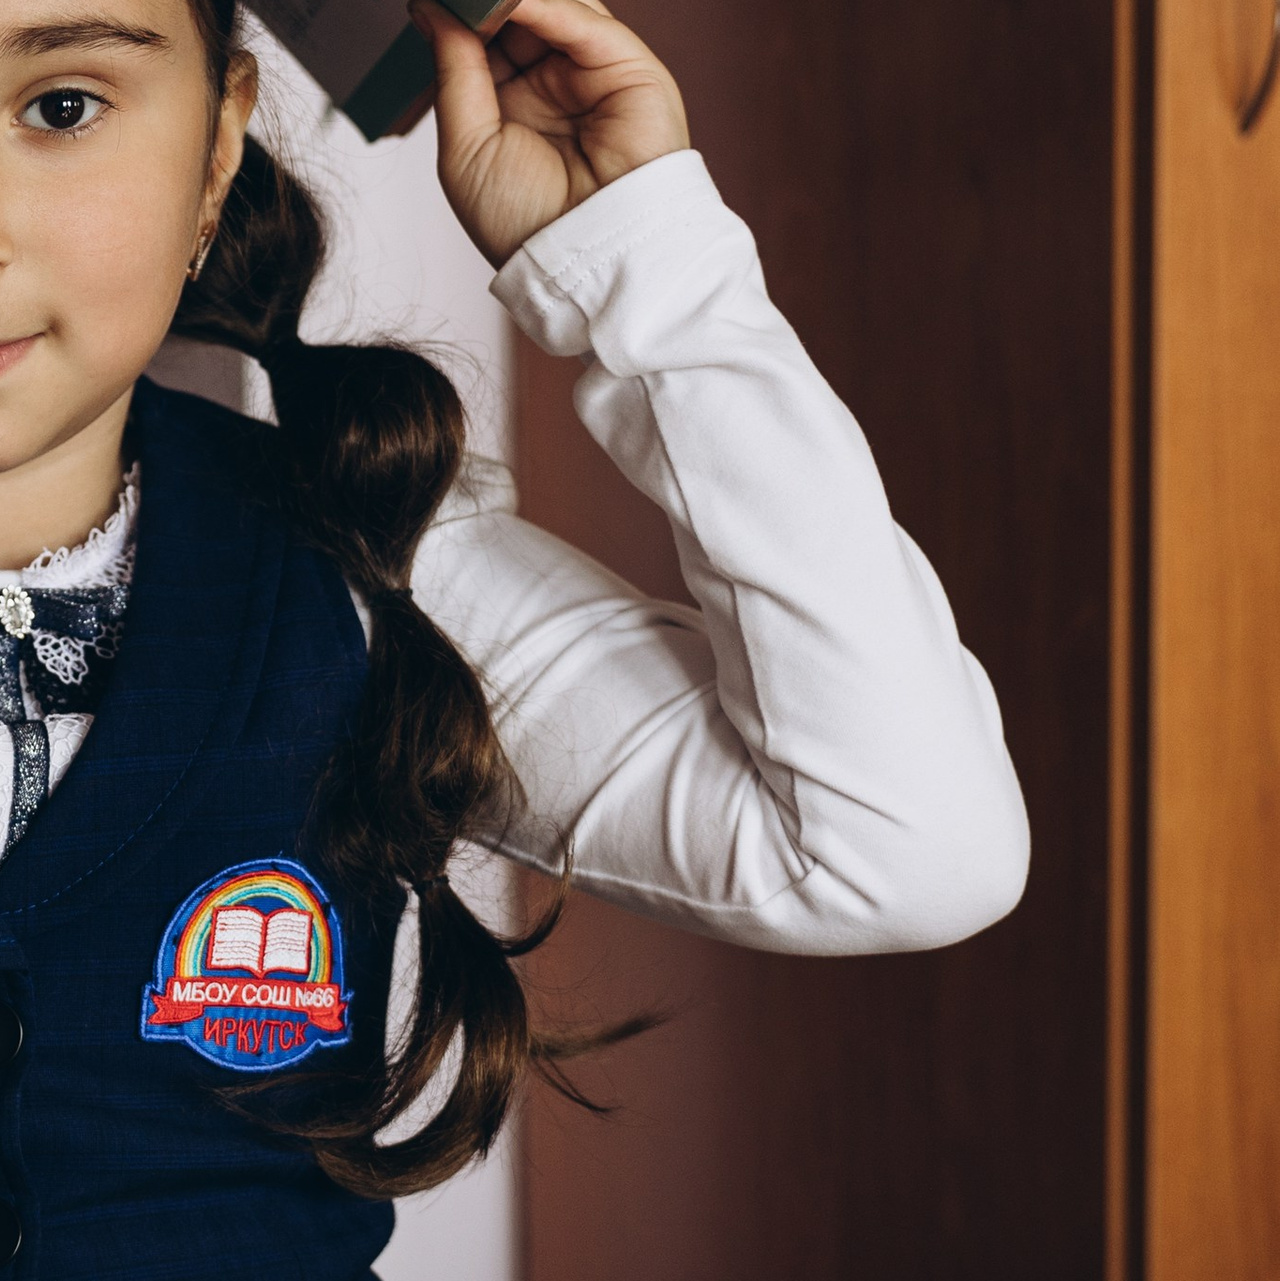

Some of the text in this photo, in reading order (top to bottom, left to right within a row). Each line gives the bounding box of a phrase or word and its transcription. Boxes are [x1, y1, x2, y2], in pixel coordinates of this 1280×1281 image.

[172, 981, 239, 1004] МБОУ
[241, 982, 292, 1007] СОШ
[203, 1017, 308, 1055] ИРКУТСК
